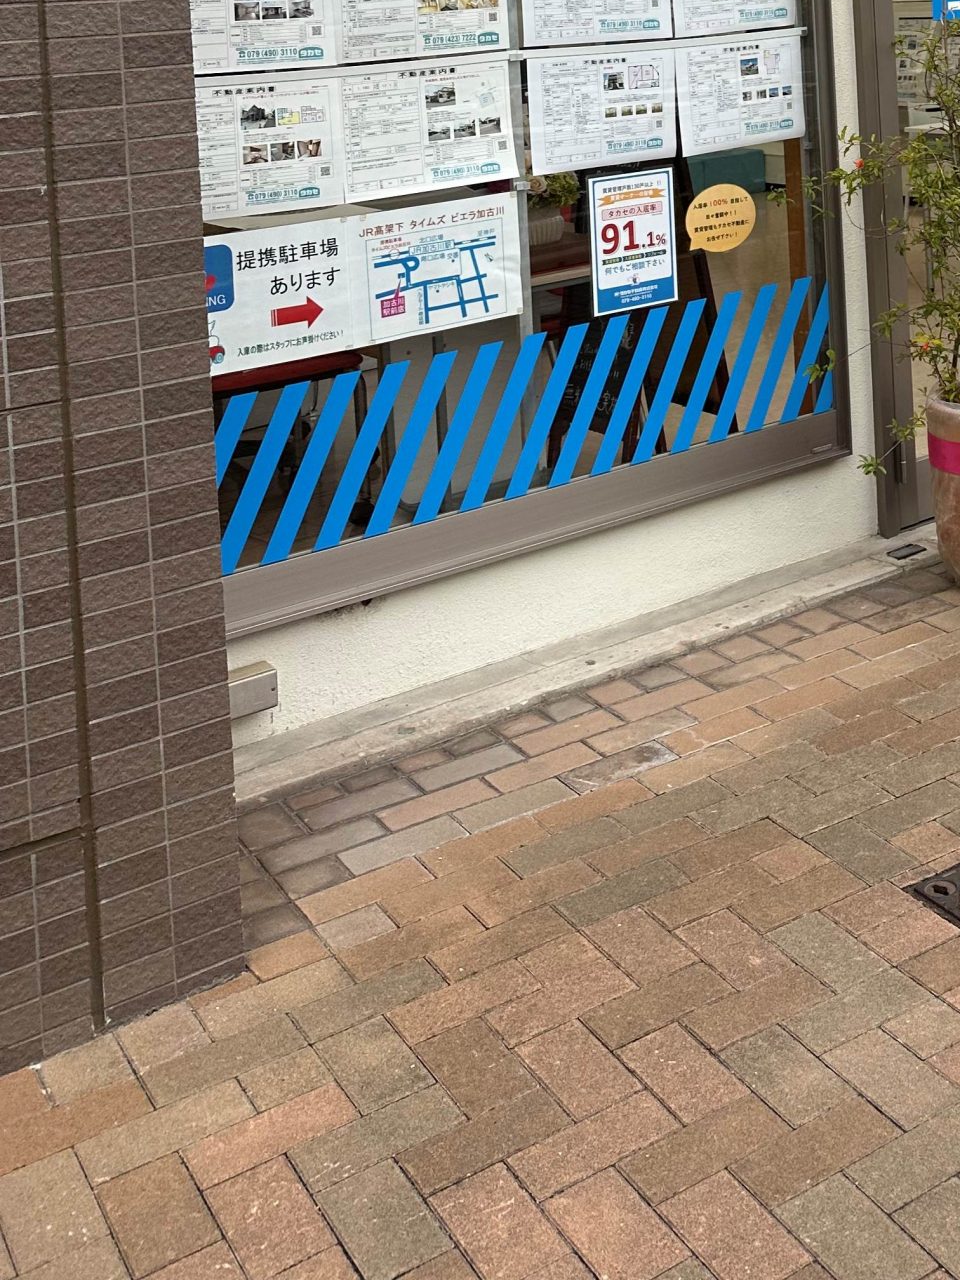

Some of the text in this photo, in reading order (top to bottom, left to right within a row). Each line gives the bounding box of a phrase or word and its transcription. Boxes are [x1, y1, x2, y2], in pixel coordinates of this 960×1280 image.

[246, 49, 260, 58] 079
[280, 48, 298, 56] 3110
[359, 206, 505, 238] JR高架下 タイムズ ビエラ加古川
[601, 219, 666, 255] 91.1%
[236, 237, 339, 271] 提携駐車場
[270, 266, 341, 295] あります
